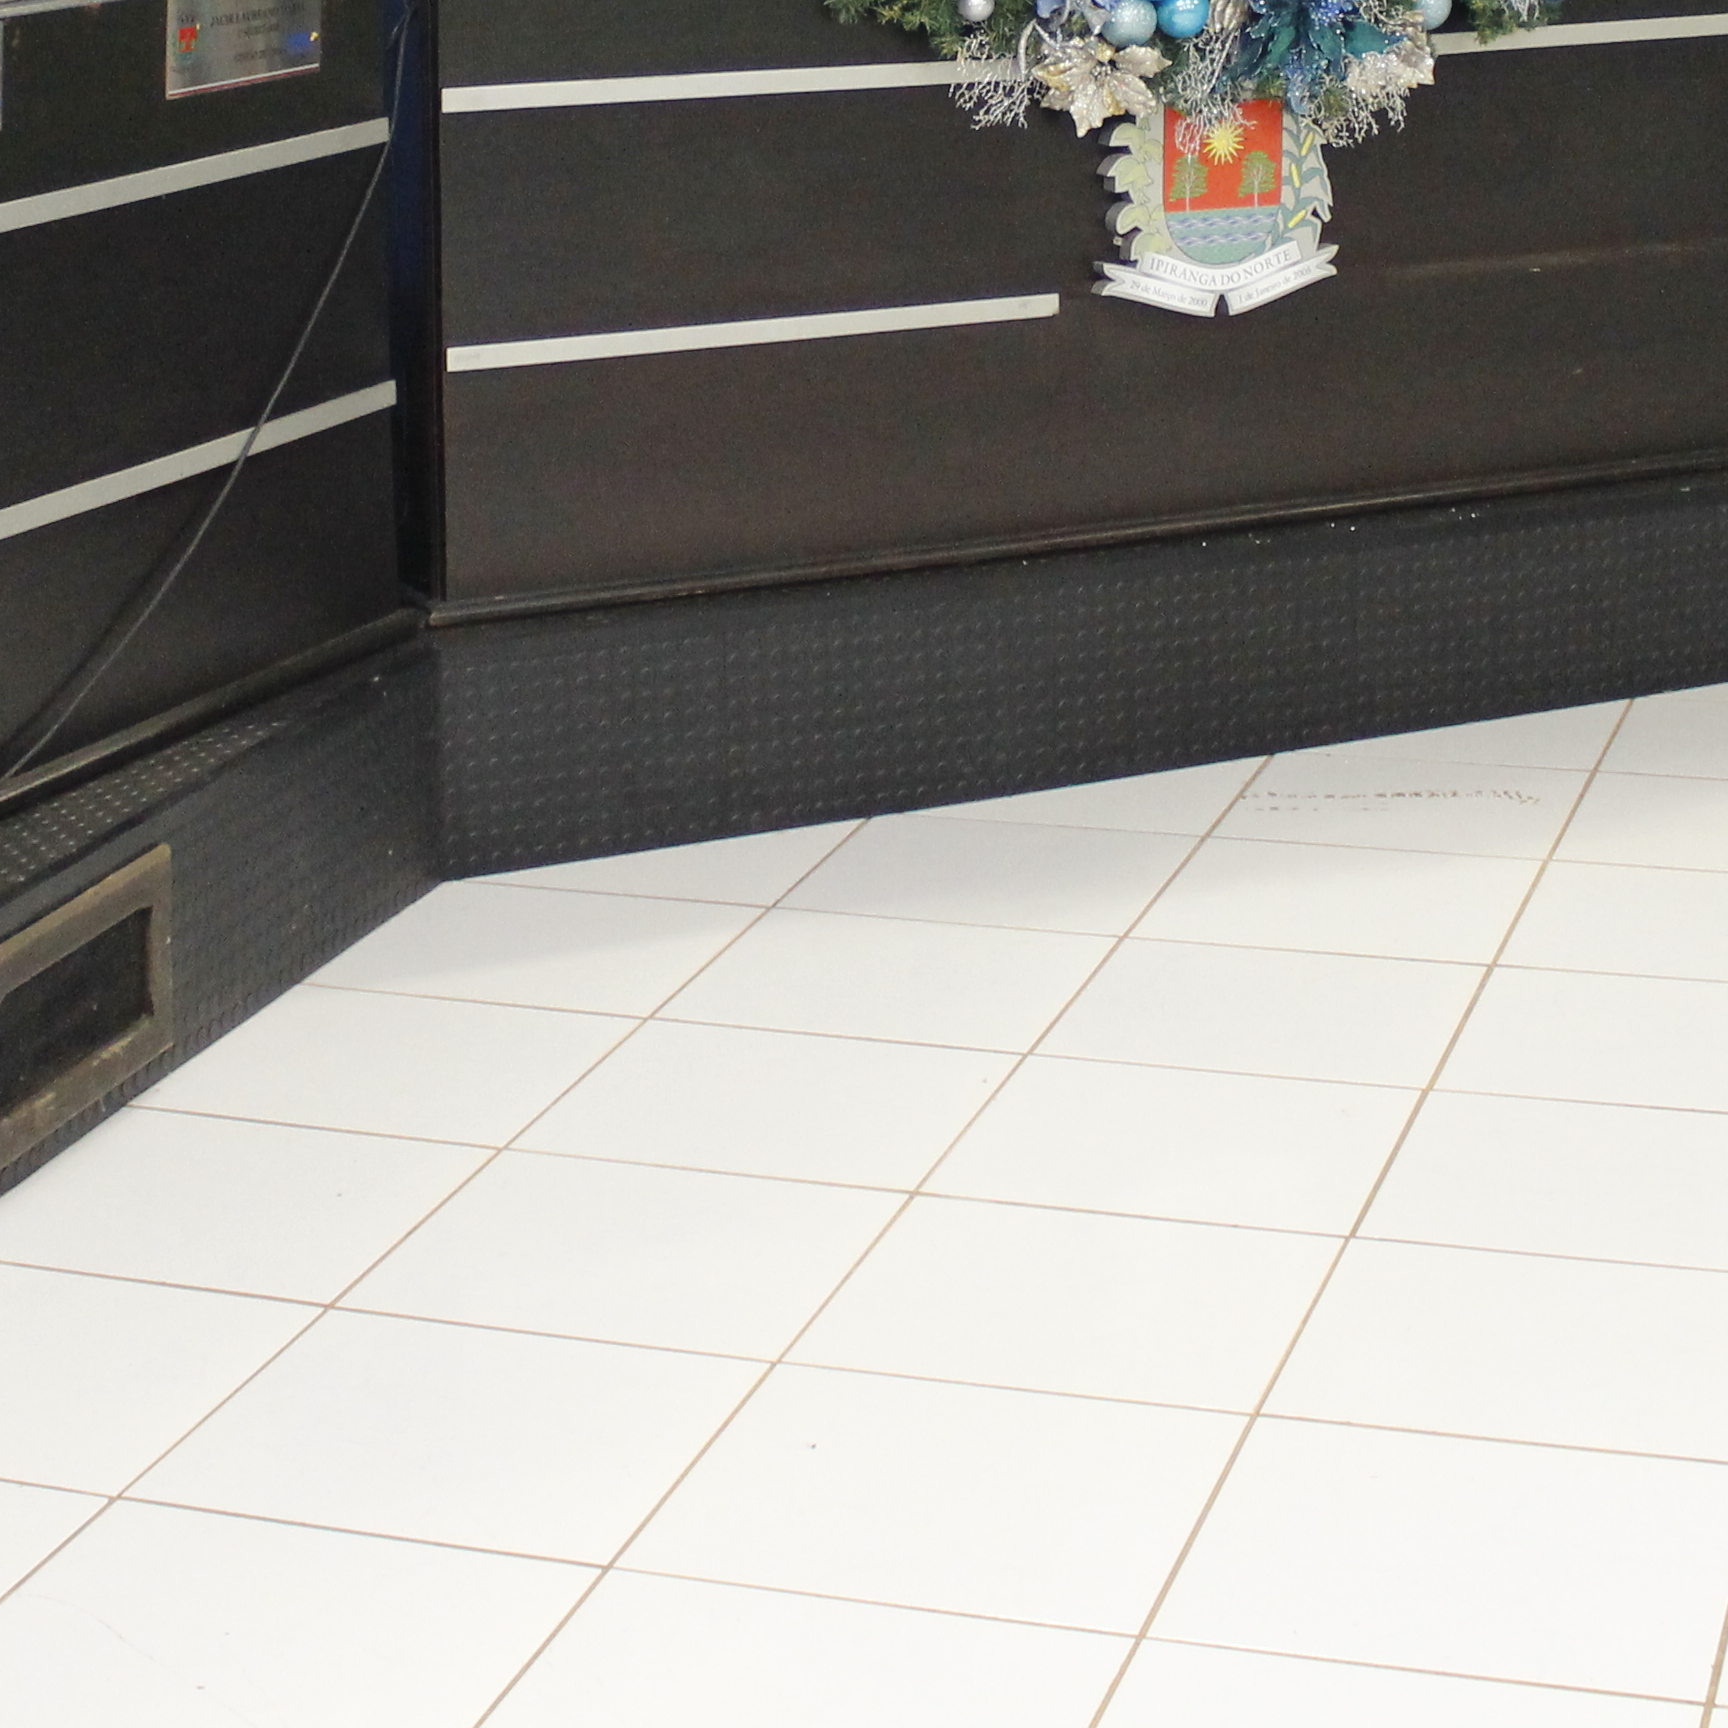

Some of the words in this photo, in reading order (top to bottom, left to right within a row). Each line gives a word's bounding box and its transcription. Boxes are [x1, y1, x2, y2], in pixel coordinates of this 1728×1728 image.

[1150, 257, 1217, 287] IPIRANGA
[1221, 272, 1241, 286] DO
[1242, 248, 1290, 280] NORTE
